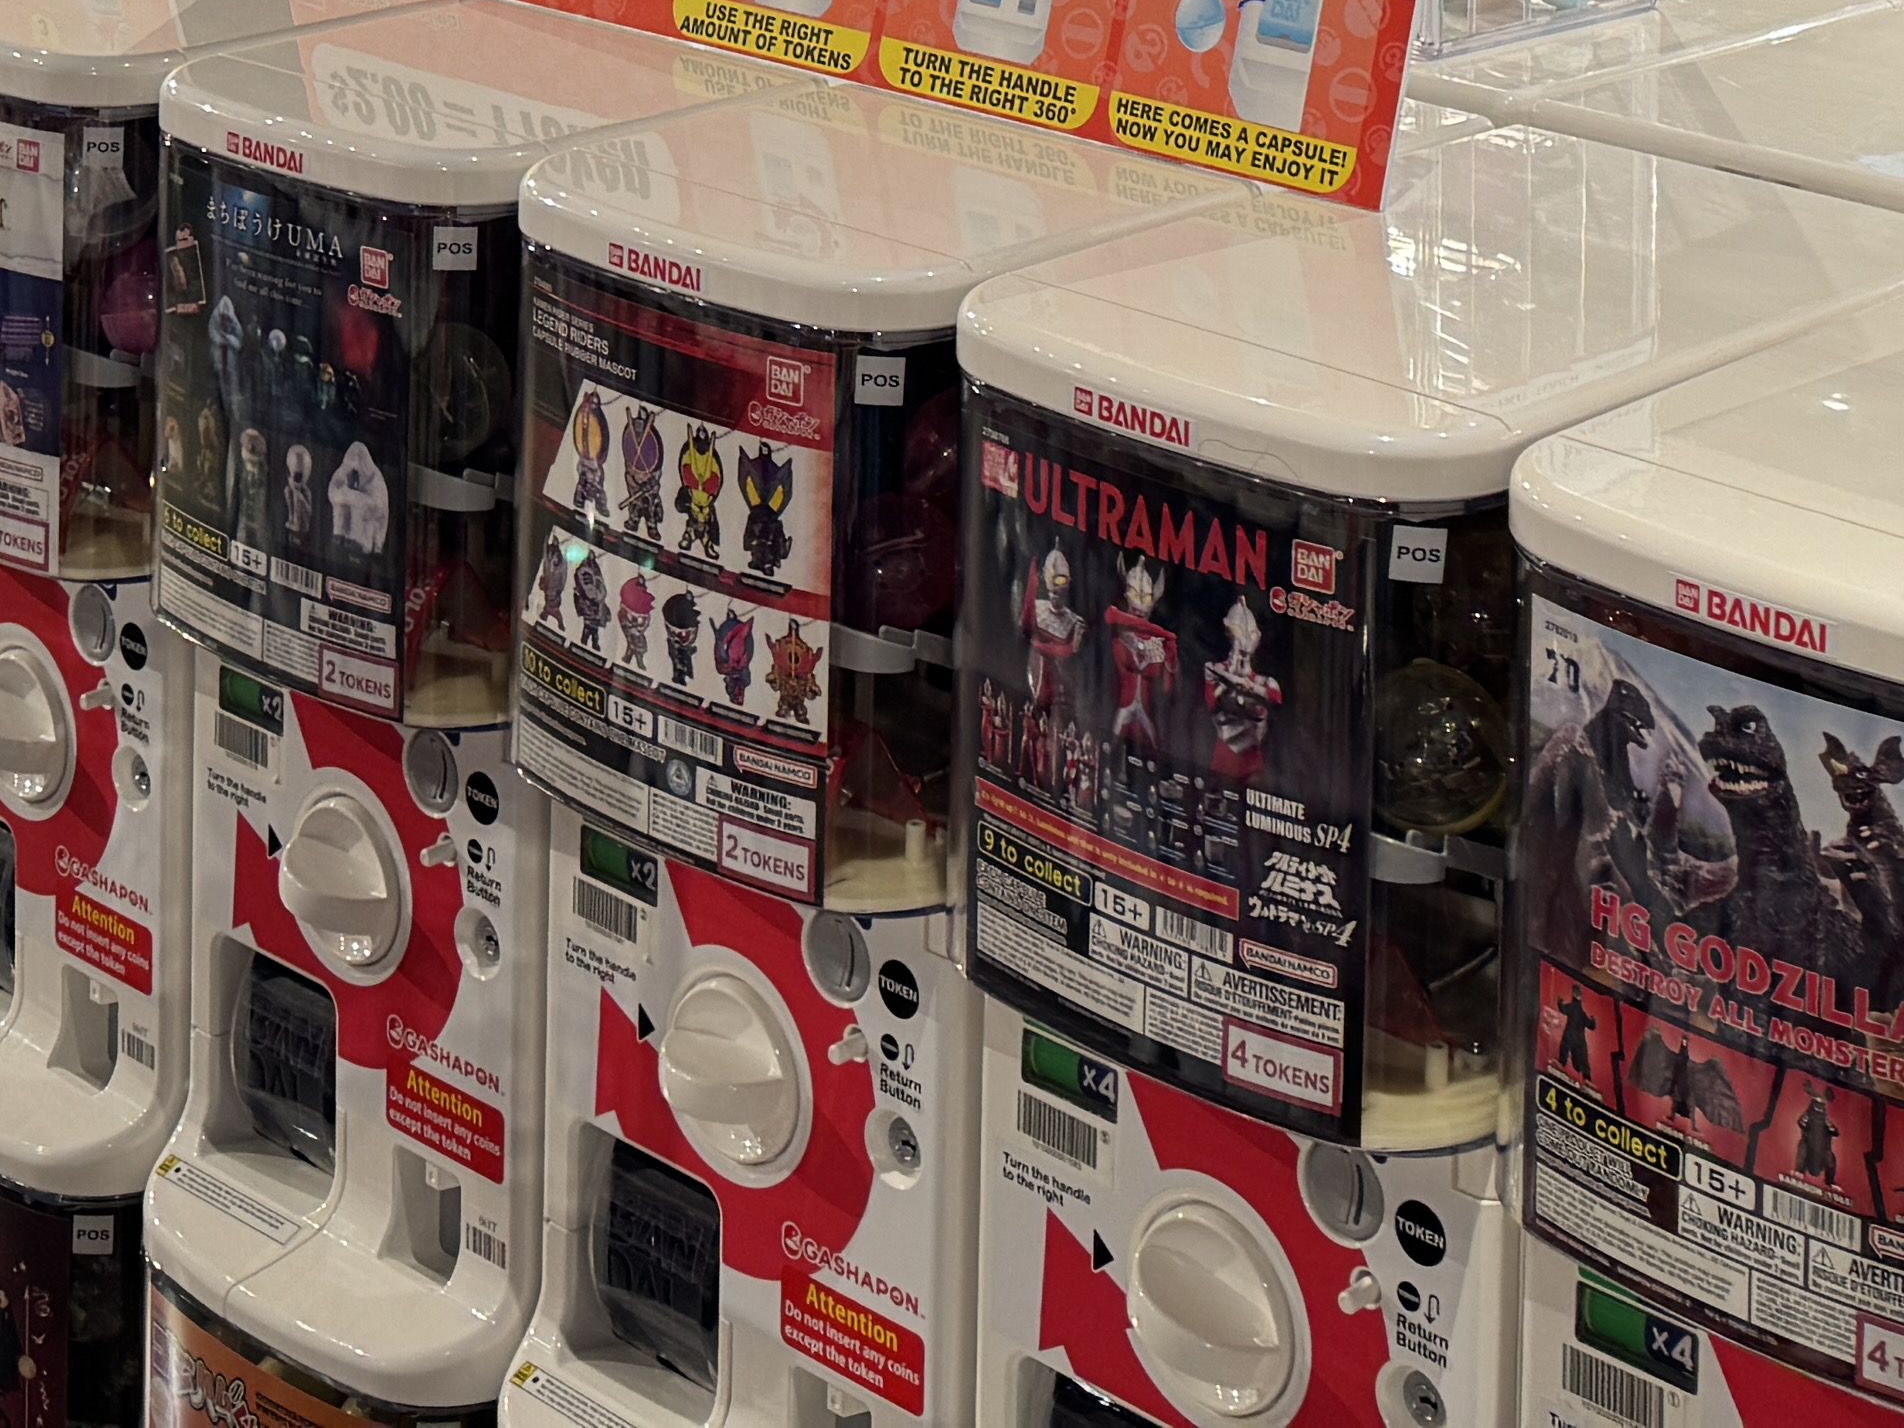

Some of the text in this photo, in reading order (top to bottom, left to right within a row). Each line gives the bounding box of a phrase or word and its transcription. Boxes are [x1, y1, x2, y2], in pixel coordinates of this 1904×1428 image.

[680, 16, 852, 72] AMOUNT OF TOKENS
[706, 0, 833, 47] USE THE RIGHT
[898, 66, 1078, 126] TO THE RIGHT 360°
[902, 47, 1076, 106] TURN THE HANDLE
[87, 140, 121, 154] POS
[242, 136, 304, 174] BANDAI
[1116, 97, 1348, 170] HERE COMES A CAPSULE!
[1116, 118, 1339, 187] NOW YOU MAY ENJOY IT
[437, 240, 473, 256] POS
[628, 251, 701, 293] BANDAI
[532, 308, 609, 354] LEGEND RIDERS
[861, 372, 901, 389] POS
[1096, 394, 1192, 447] BANDAI
[1022, 451, 1268, 592] ULTRAMAN
[1397, 545, 1443, 565] POS
[1707, 588, 1828, 654] BANDAI
[325, 660, 392, 700] 2 TOKENS
[730, 780, 791, 811] WARNING:
[1246, 789, 1306, 821] ULTIMATE
[1246, 810, 1353, 855] LUMINOUS SP4
[725, 832, 806, 882] 2 TOKENS
[1590, 887, 1651, 946] HG
[879, 974, 917, 1002] TOKEN
[1590, 940, 1701, 1012] DESTROY
[1707, 998, 1763, 1038] ALL
[880, 1062, 922, 1095] Return
[1230, 1038, 1331, 1095] 4 TOKENS
[880, 1078, 921, 1111] Button
[1544, 1085, 1671, 1172] 4 to collect
[1691, 1160, 1749, 1199] 15+
[1717, 1205, 1802, 1257] WARNING:
[806, 1283, 899, 1353] Attention
[1866, 1339, 1889, 1374] 4
